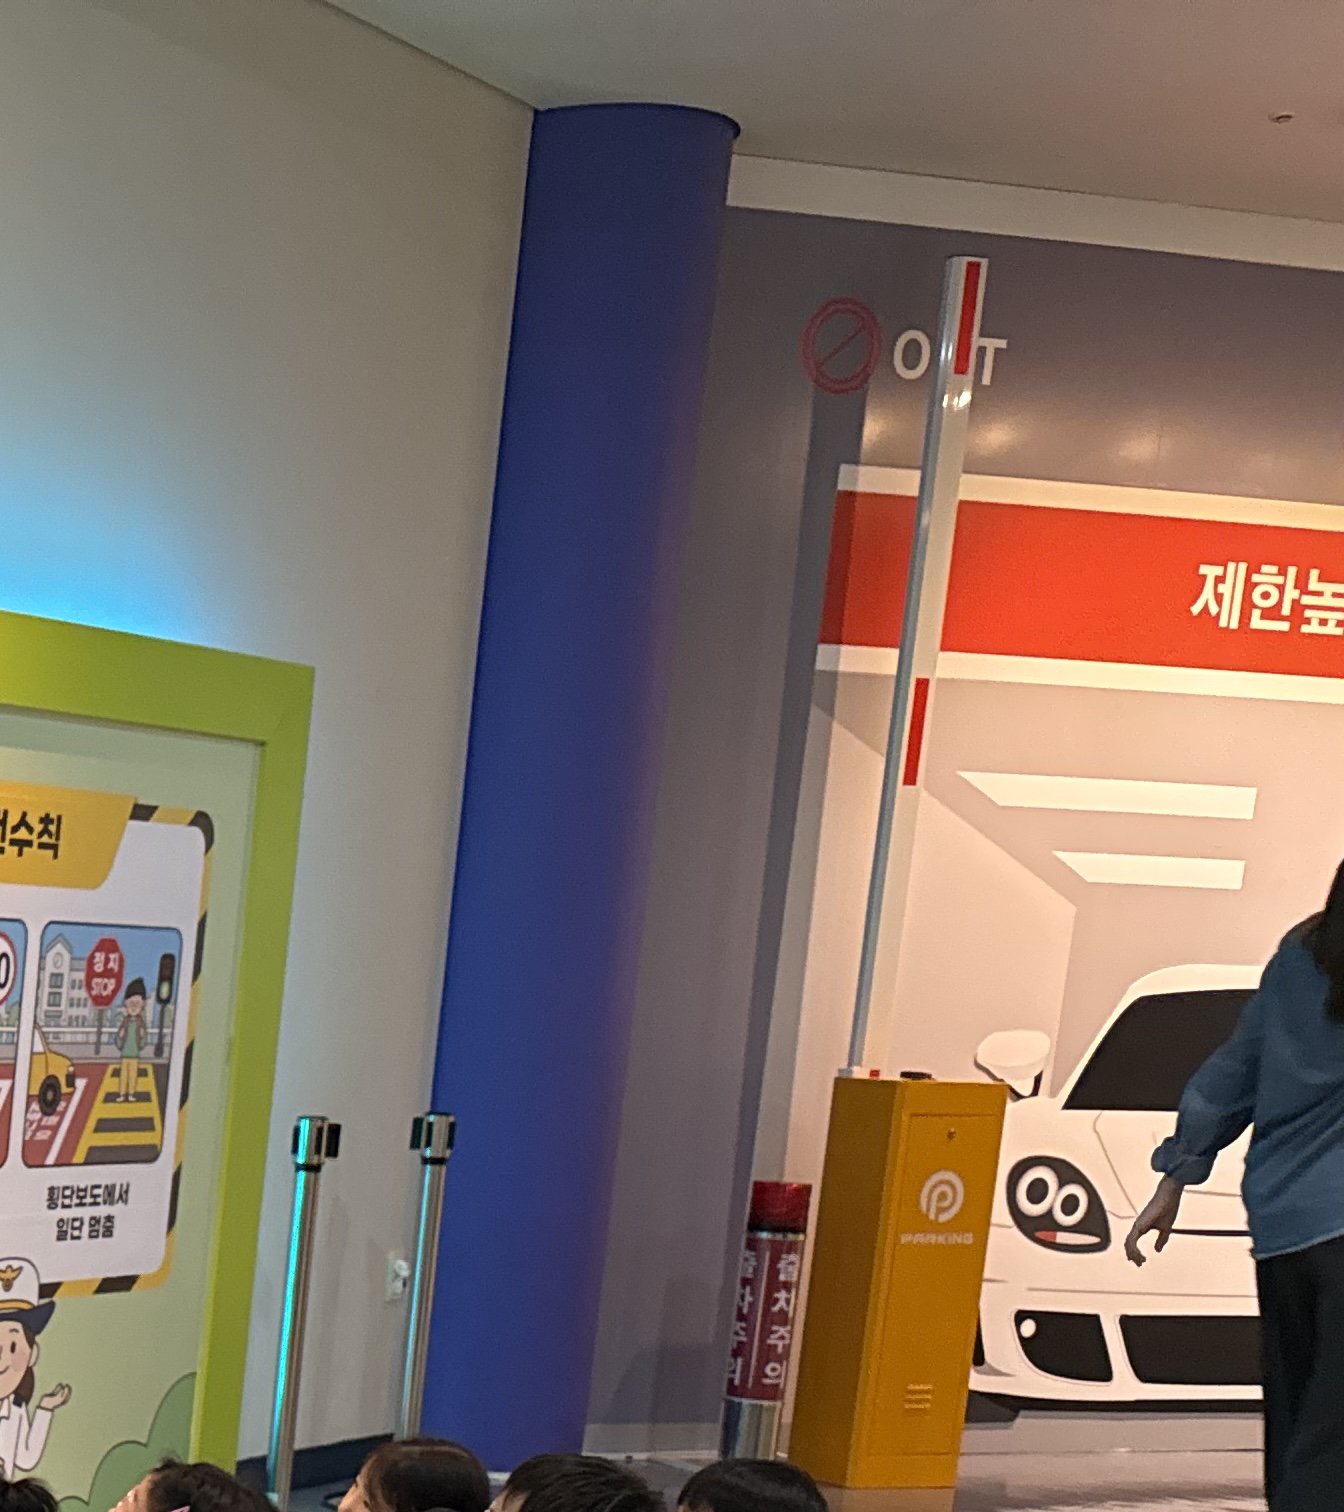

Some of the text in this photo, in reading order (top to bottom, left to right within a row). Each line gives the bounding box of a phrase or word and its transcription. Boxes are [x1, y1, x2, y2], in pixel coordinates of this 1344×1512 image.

[893, 329, 1008, 386] OT
[1189, 561, 1344, 636] 제한높
[91, 977, 116, 996] STOP
[45, 1182, 130, 1211] 횡단보도에서
[55, 1214, 116, 1242] 일단 멈춤
